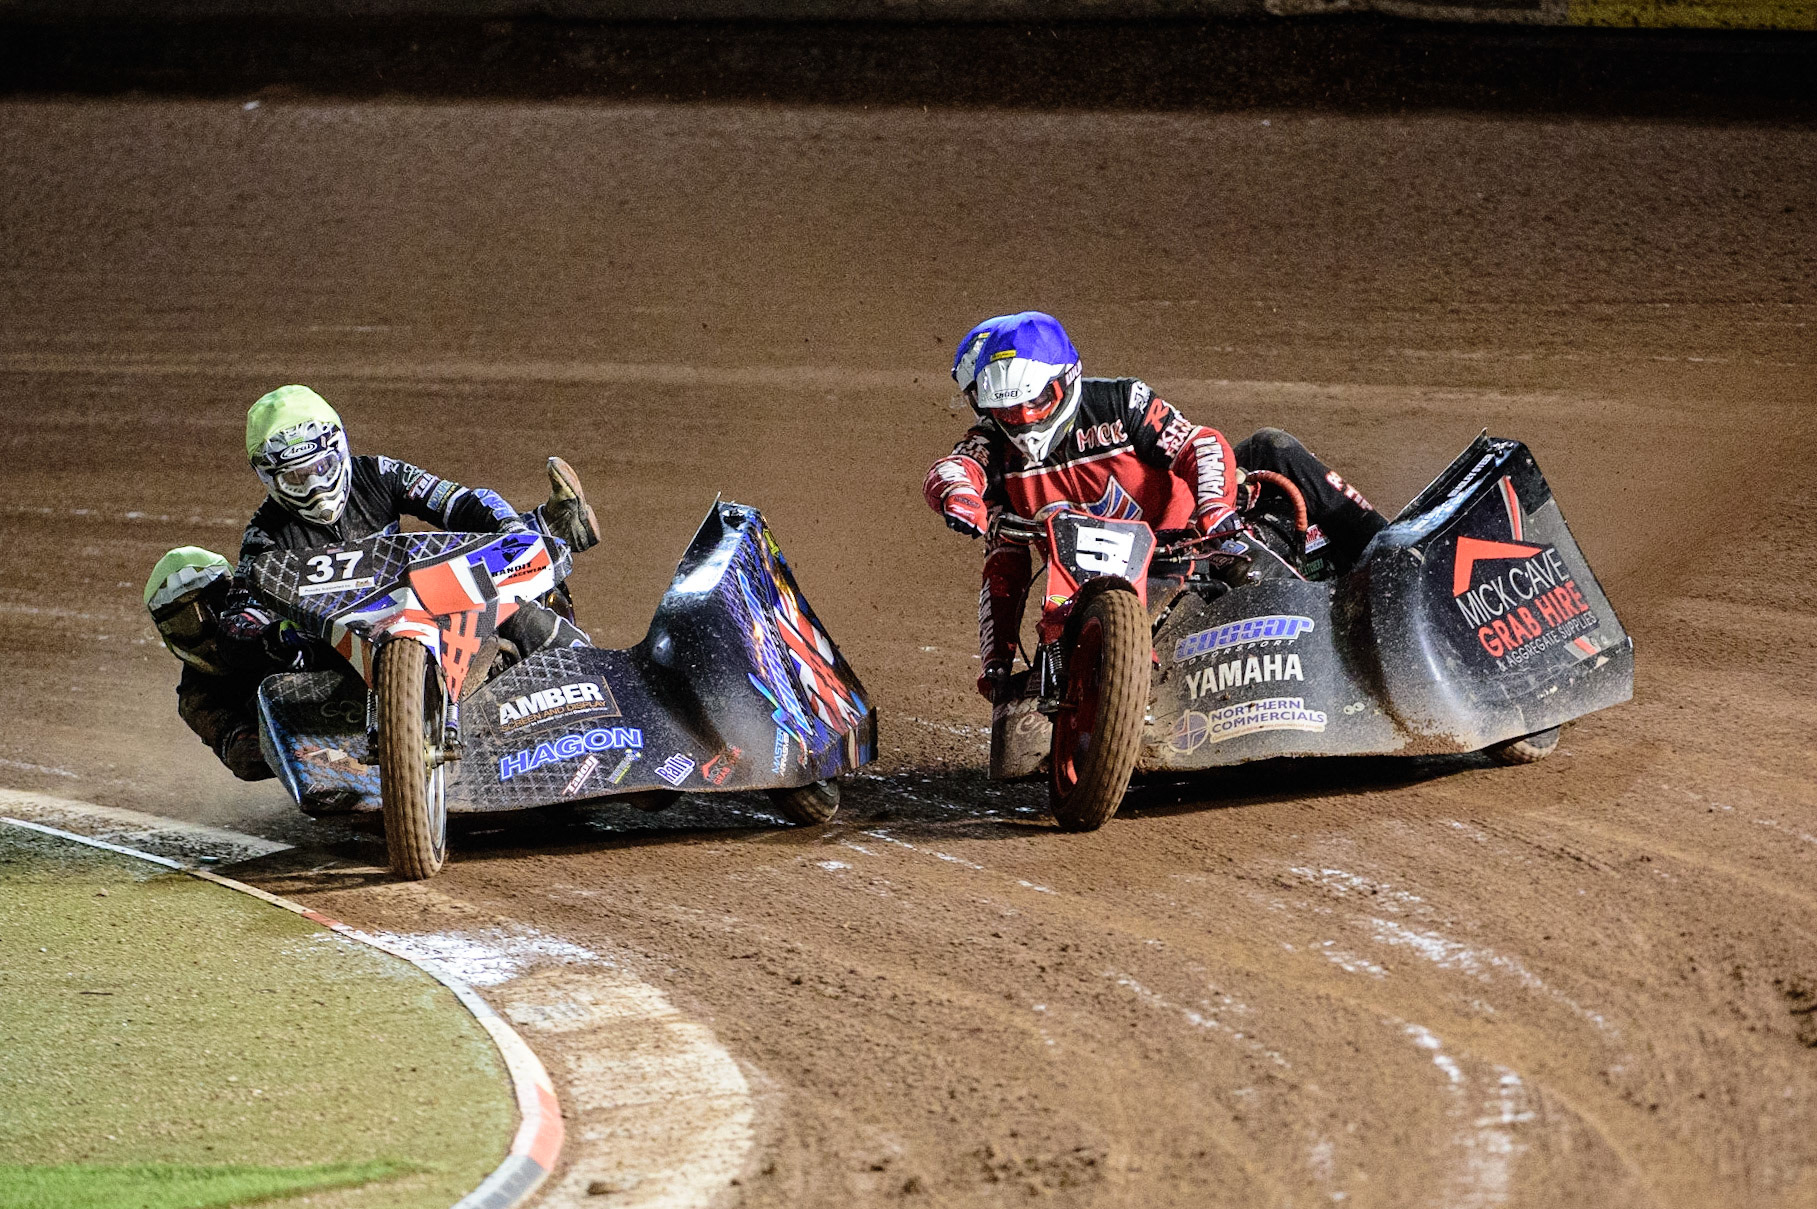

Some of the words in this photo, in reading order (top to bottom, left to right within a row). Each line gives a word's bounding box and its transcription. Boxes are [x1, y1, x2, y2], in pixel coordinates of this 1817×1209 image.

[994, 390, 1018, 399] SHOEI
[281, 442, 316, 459] Arai
[1076, 419, 1128, 452] MICK
[1193, 436, 1225, 505] YAMAHA
[306, 550, 364, 583] 37
[1076, 526, 1135, 577] 5
[492, 561, 532, 577] BANDIT
[508, 565, 547, 579] RACEWEAR
[1456, 576, 1517, 629] MICK
[1508, 548, 1570, 600] CAVE
[1478, 606, 1542, 657] GRAB
[1535, 580, 1589, 628] HIRE
[1174, 640, 1295, 668] MOTORSPORT
[1507, 635, 1561, 666] AGGREGATE
[1558, 613, 1597, 639] SUPPLIES
[1186, 654, 1304, 699] YAMAHA
[500, 683, 604, 725] AMBER
[502, 713, 541, 731] SCREEN
[543, 707, 565, 718] AND
[567, 701, 606, 712] DISPLAY
[1212, 700, 1300, 721] NORTHERN
[1213, 711, 1325, 734] COMMERCIALS
[500, 728, 643, 780] HAGON
[771, 727, 783, 773] MASTER
[656, 753, 694, 782] Rally
